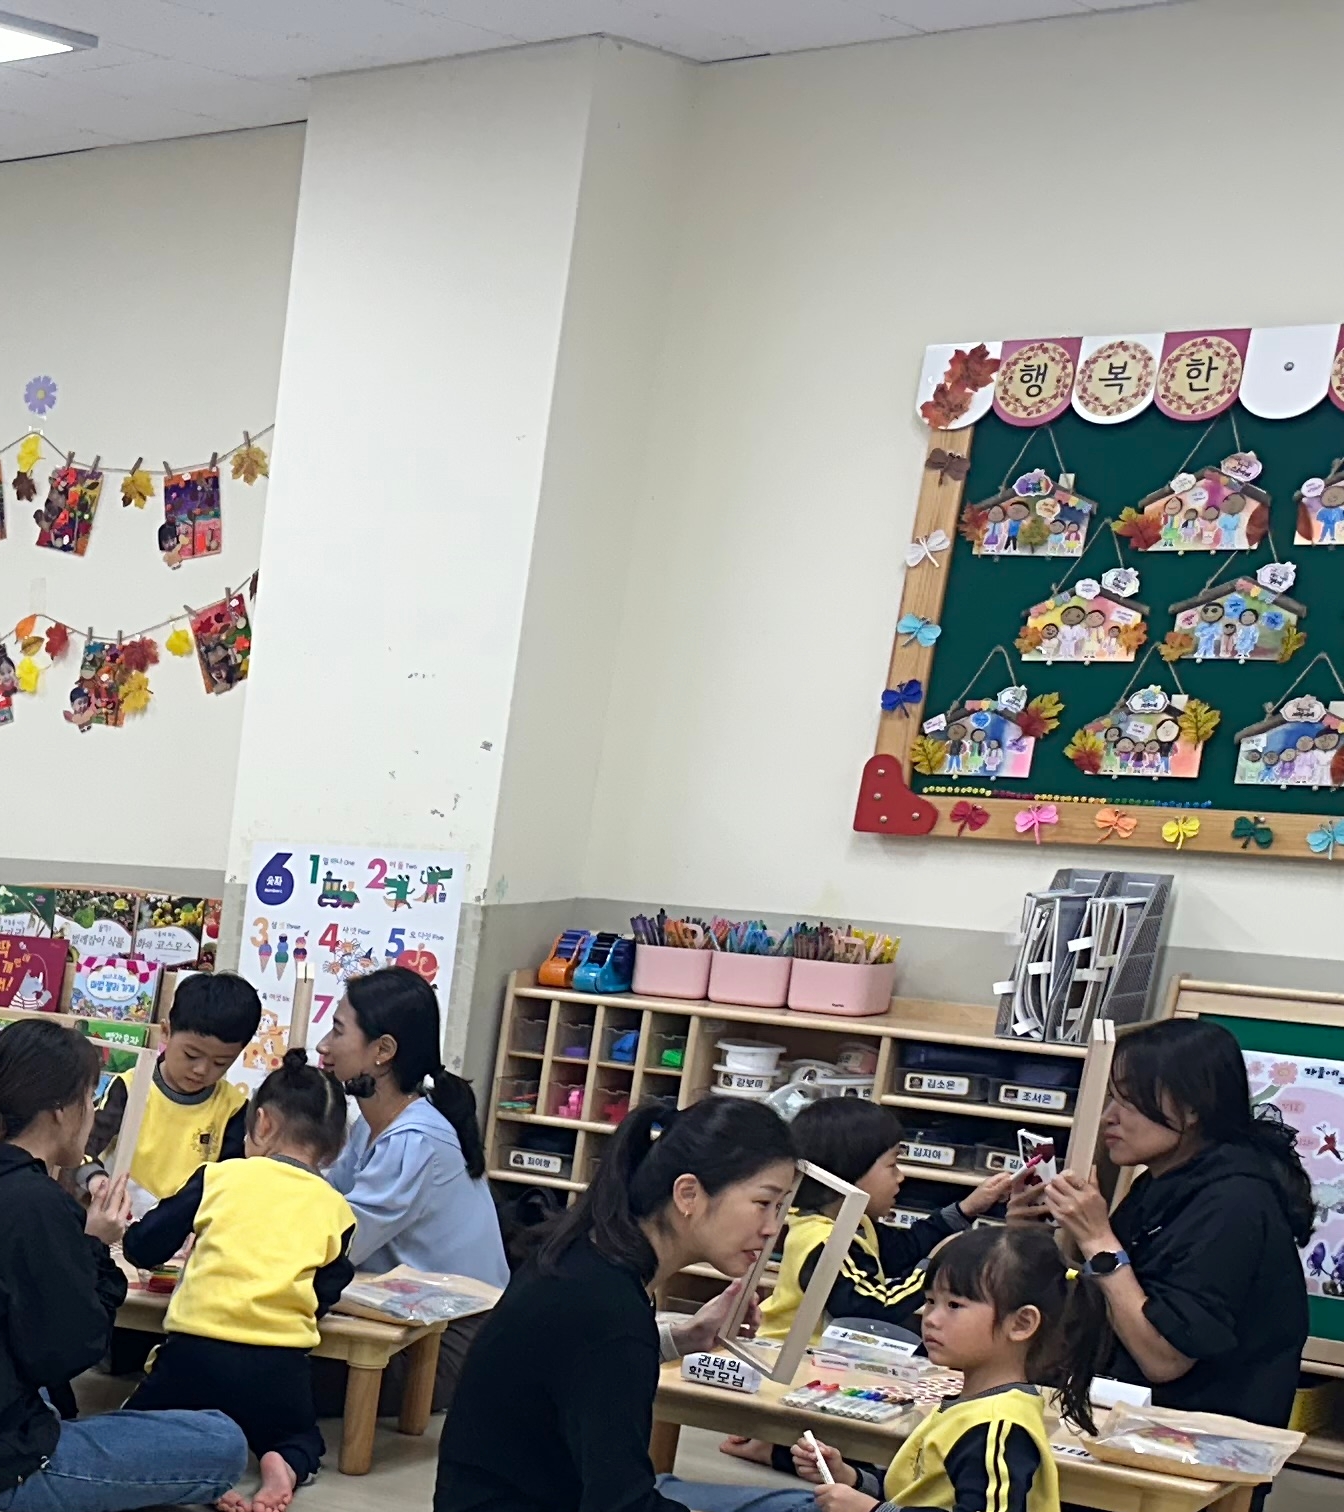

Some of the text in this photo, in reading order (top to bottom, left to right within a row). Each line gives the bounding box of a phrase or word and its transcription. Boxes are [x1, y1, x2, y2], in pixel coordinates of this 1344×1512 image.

[255, 853, 295, 906] 6
[309, 854, 320, 884] 1
[365, 858, 388, 890] 2
[250, 917, 269, 947] 3
[318, 923, 339, 953] 4
[385, 928, 405, 959] 5
[312, 994, 334, 1023] 7
[688, 1365, 745, 1389] 학부모님
